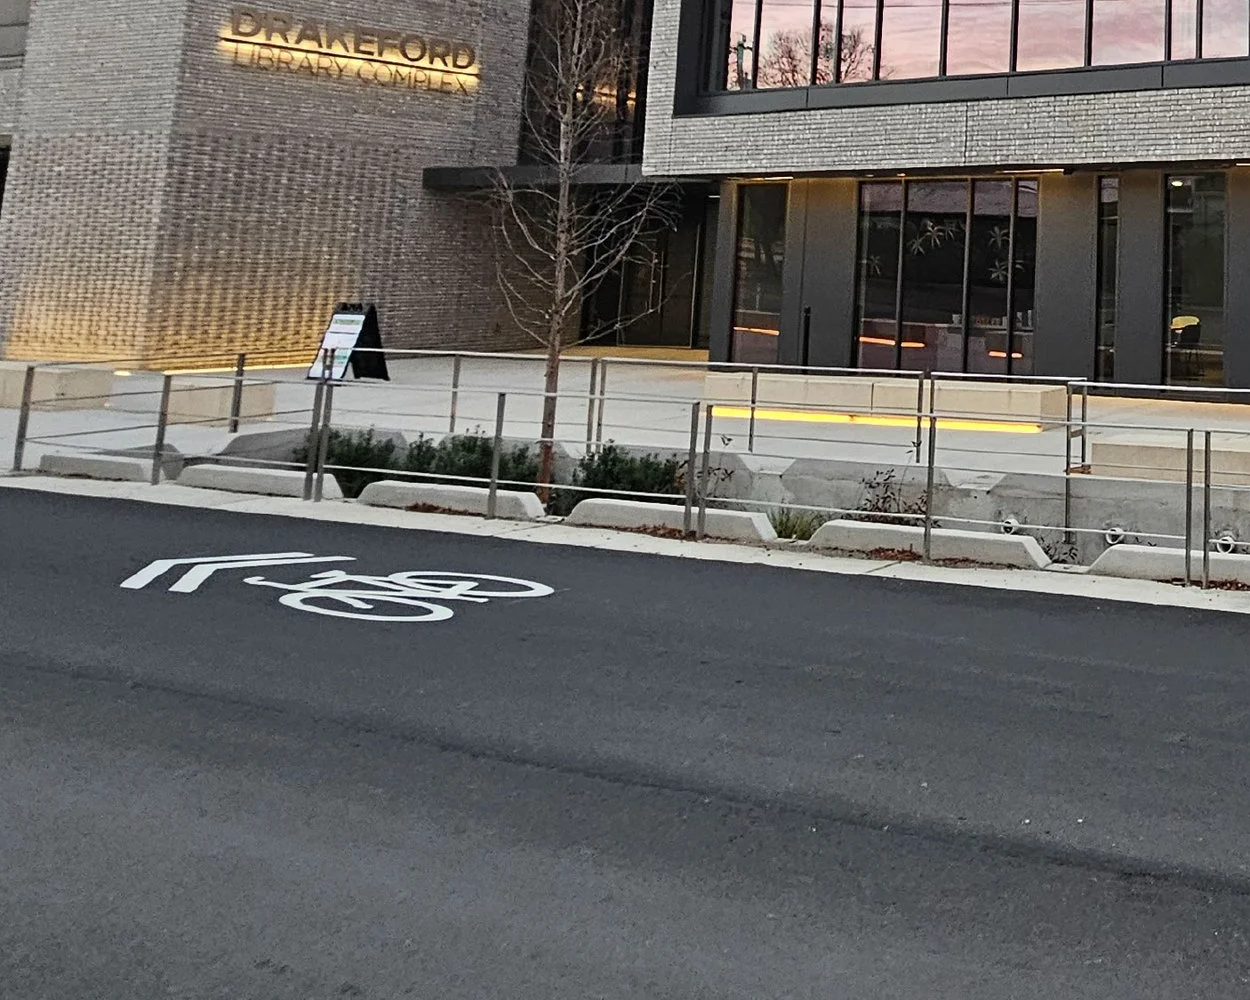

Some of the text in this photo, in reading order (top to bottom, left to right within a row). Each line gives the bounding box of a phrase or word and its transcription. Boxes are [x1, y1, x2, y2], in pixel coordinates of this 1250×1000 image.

[230, 6, 476, 69] DRAKEFORD
[234, 44, 470, 96] LIBRARY COMPLEX
